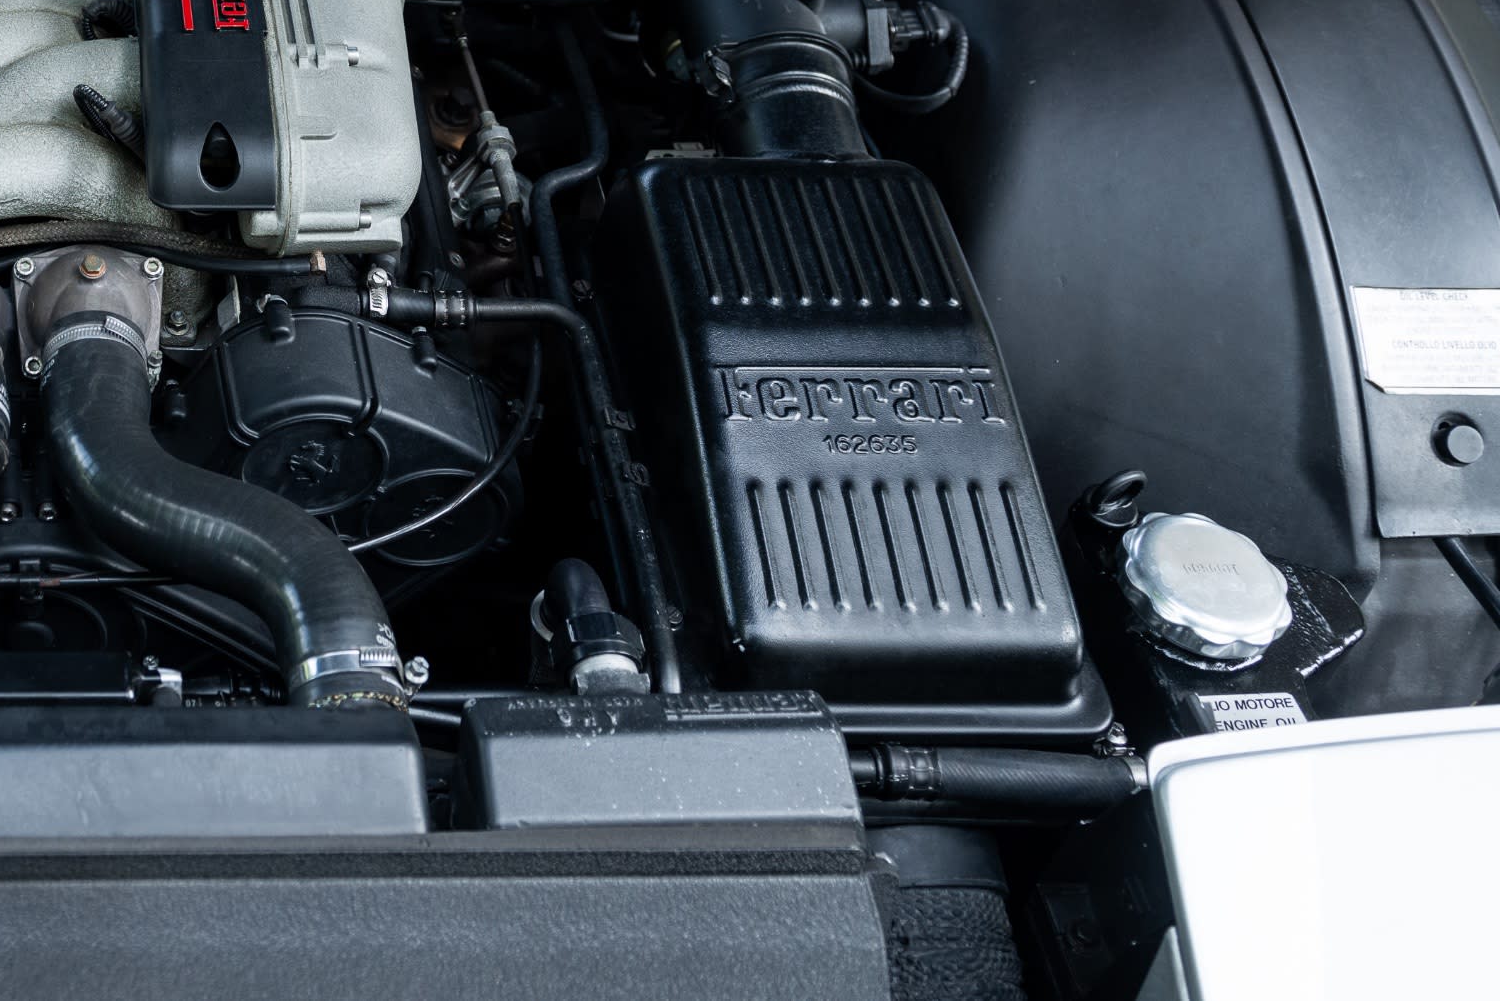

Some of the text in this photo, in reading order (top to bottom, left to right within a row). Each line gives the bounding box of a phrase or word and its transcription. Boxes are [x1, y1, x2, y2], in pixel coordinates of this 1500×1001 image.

[714, 365, 1007, 424] Ferrari
[822, 434, 919, 455] 162635
[1234, 697, 1294, 710] MOTORE
